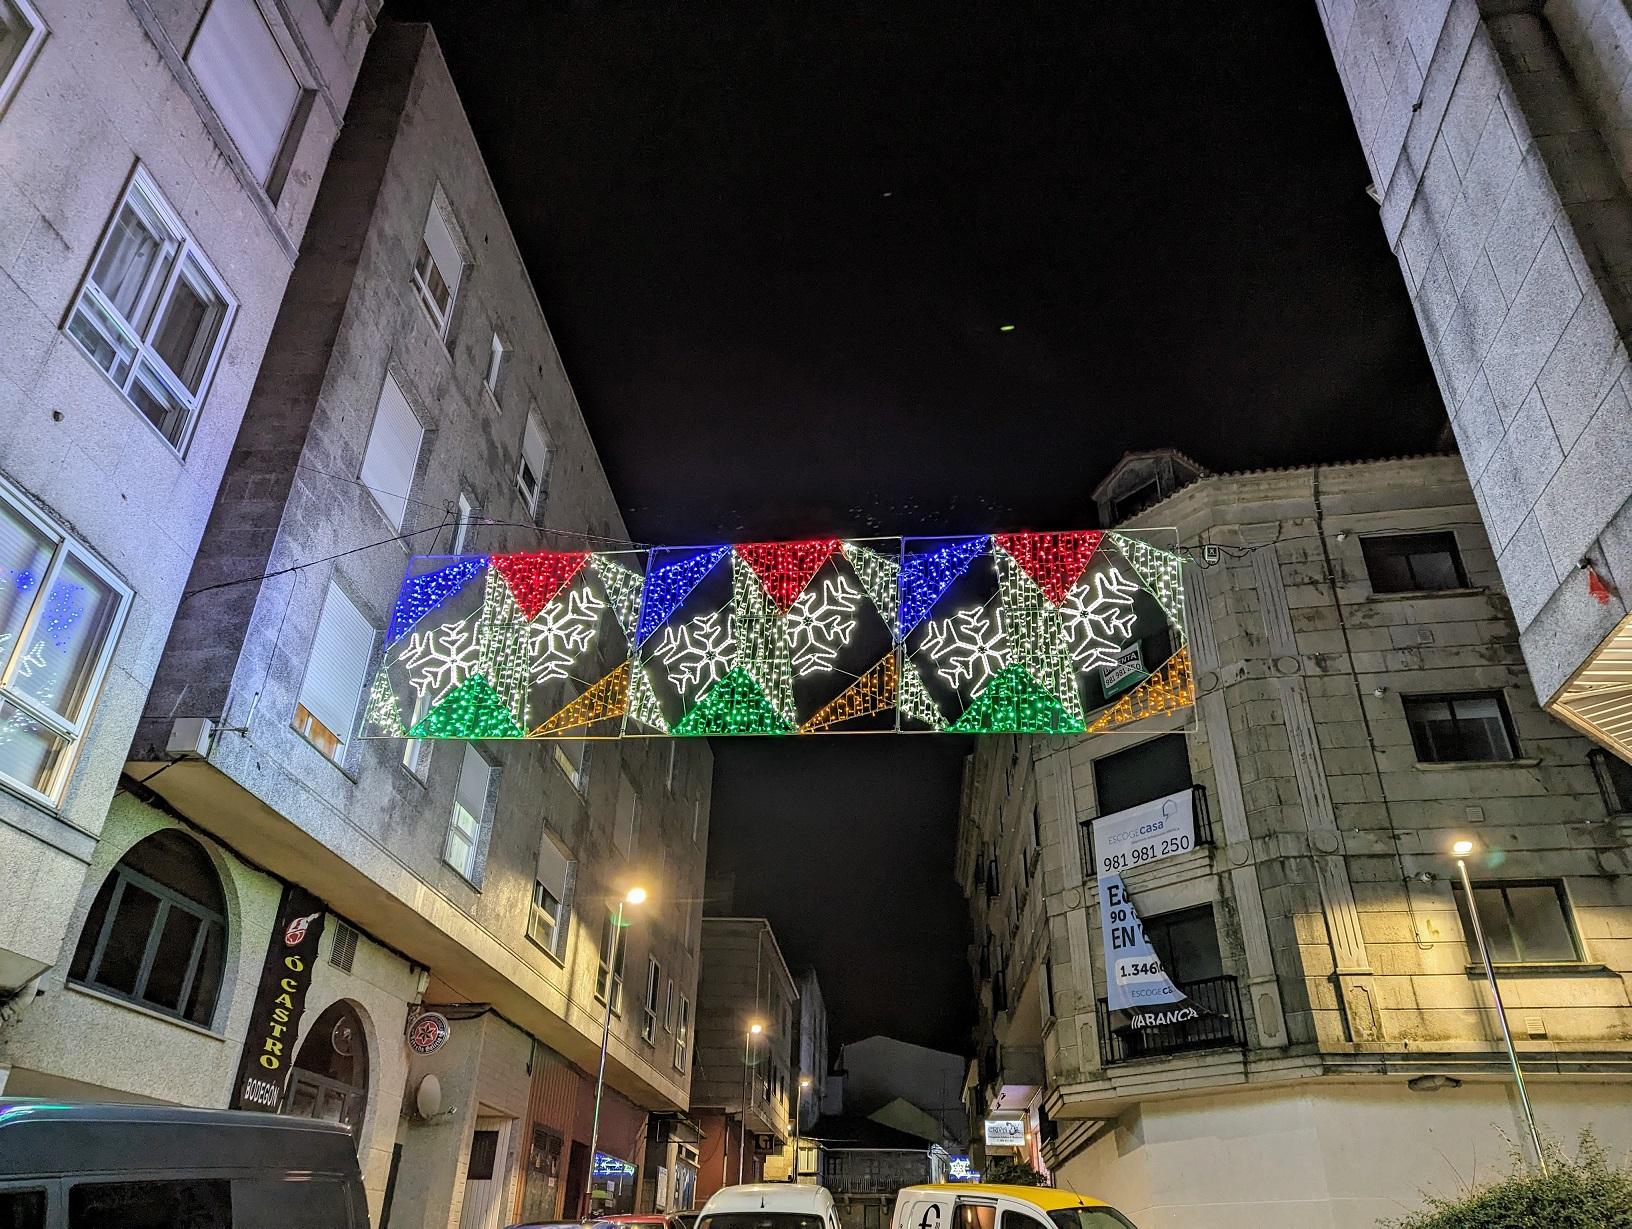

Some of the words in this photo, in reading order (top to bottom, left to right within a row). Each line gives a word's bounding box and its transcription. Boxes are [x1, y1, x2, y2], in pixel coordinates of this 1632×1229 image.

[1103, 853, 1128, 872] 981
[1131, 844, 1157, 864] 981
[1161, 835, 1190, 855] 250
[1110, 909, 1126, 924] 90
[1111, 925, 1136, 950] EN
[259, 978, 298, 1070] CASTRO
[244, 1078, 280, 1108] BODEGÓN
